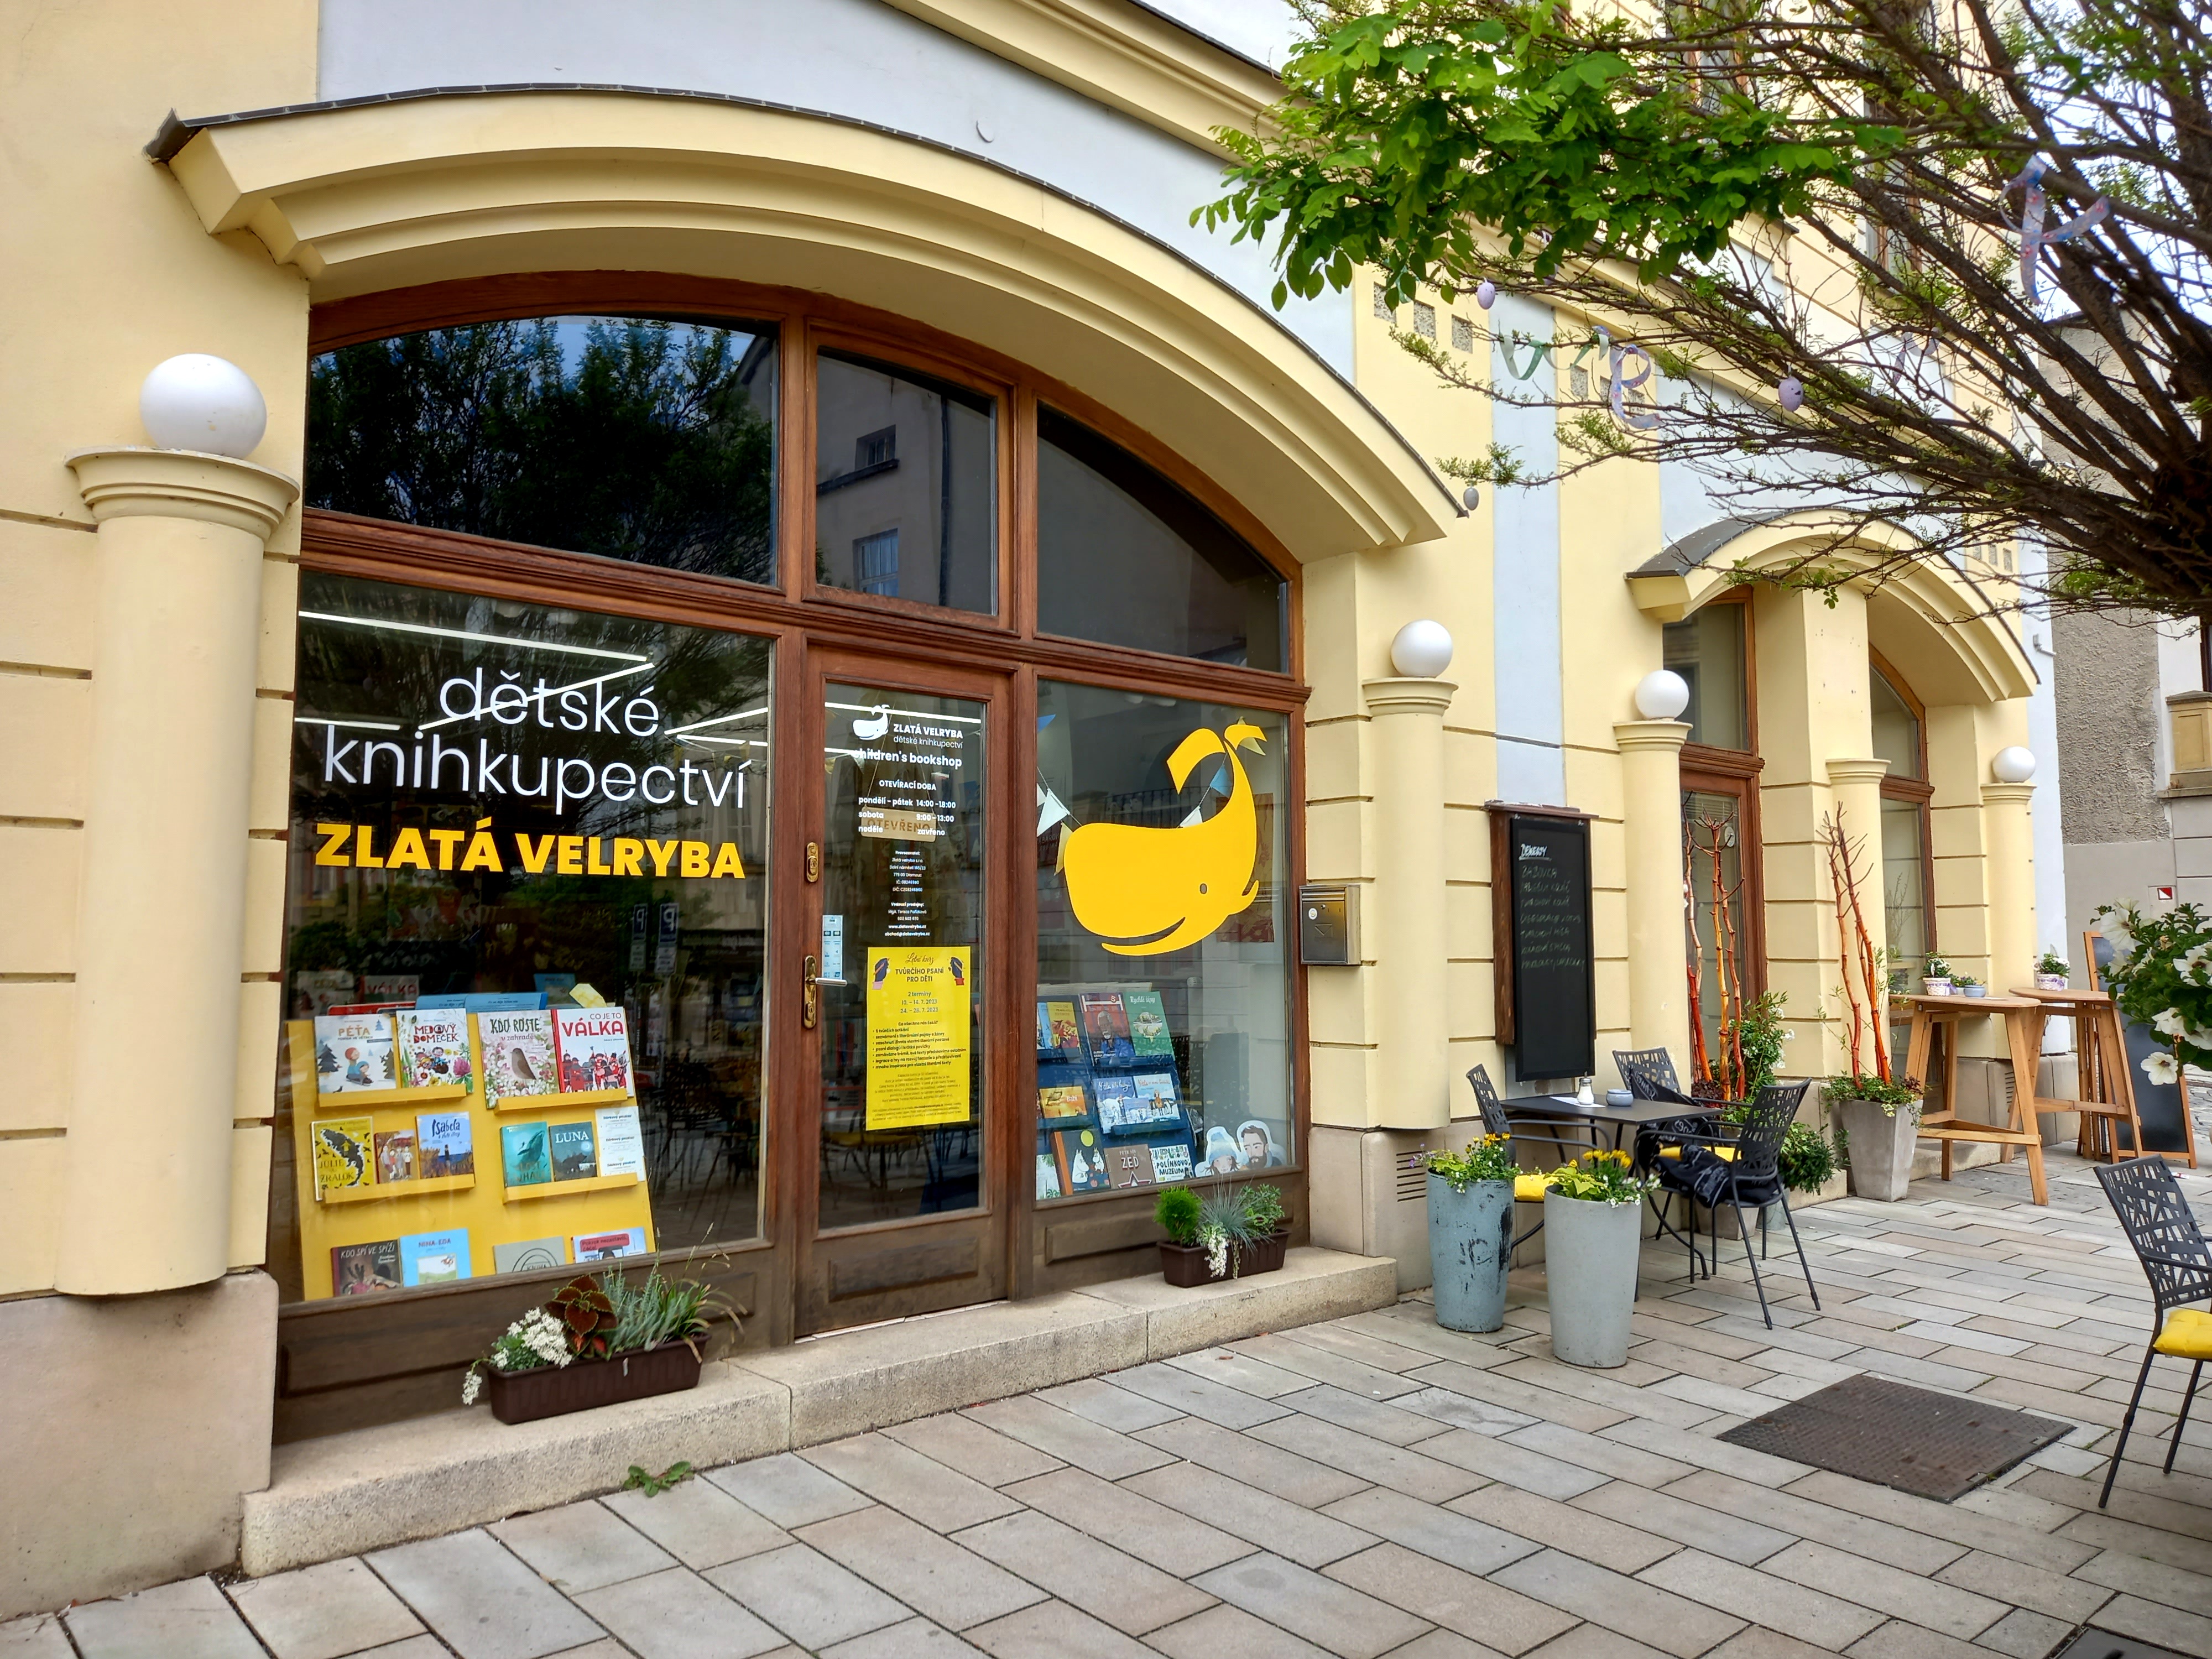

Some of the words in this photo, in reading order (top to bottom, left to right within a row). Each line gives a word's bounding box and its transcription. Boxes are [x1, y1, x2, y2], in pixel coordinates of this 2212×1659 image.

[439, 668, 660, 737] dětské
[894, 723, 922, 735] ZLATÁ
[923, 727, 963, 739] VELRYBA
[894, 735, 917, 744] dětské
[919, 739, 963, 749] knihkupectví
[910, 753, 962, 769] bookshop
[324, 724, 753, 815] knihkupectví
[879, 779, 916, 789] OTEVÍRACÍ
[917, 782, 936, 791] DOBA
[893, 797, 913, 807] pátek
[868, 818, 930, 832] OTEVŘENO
[315, 817, 503, 872] ZLATÁ
[514, 833, 746, 879] VELRYBA
[1146, 995, 1155, 1004] šípy
[338, 1025, 371, 1036] PÉŤA
[415, 1024, 456, 1035] MEDOVÝ
[490, 1019, 511, 1034] KDO
[513, 1018, 542, 1032] ROSTE
[562, 1018, 624, 1037] VÁLKA
[413, 1033, 459, 1044] DOMEČEK
[432, 1119, 460, 1137] Isabela
[555, 1131, 589, 1143] LUNA
[319, 1159, 343, 1169] JULIE
[1121, 1156, 1139, 1168] ZEĎ
[1157, 1159, 1188, 1168] POLÍNKOVO
[341, 1249, 355, 1259] KDO
[356, 1245, 367, 1256] SPÍ
[378, 1242, 394, 1253] SPÍŽI
